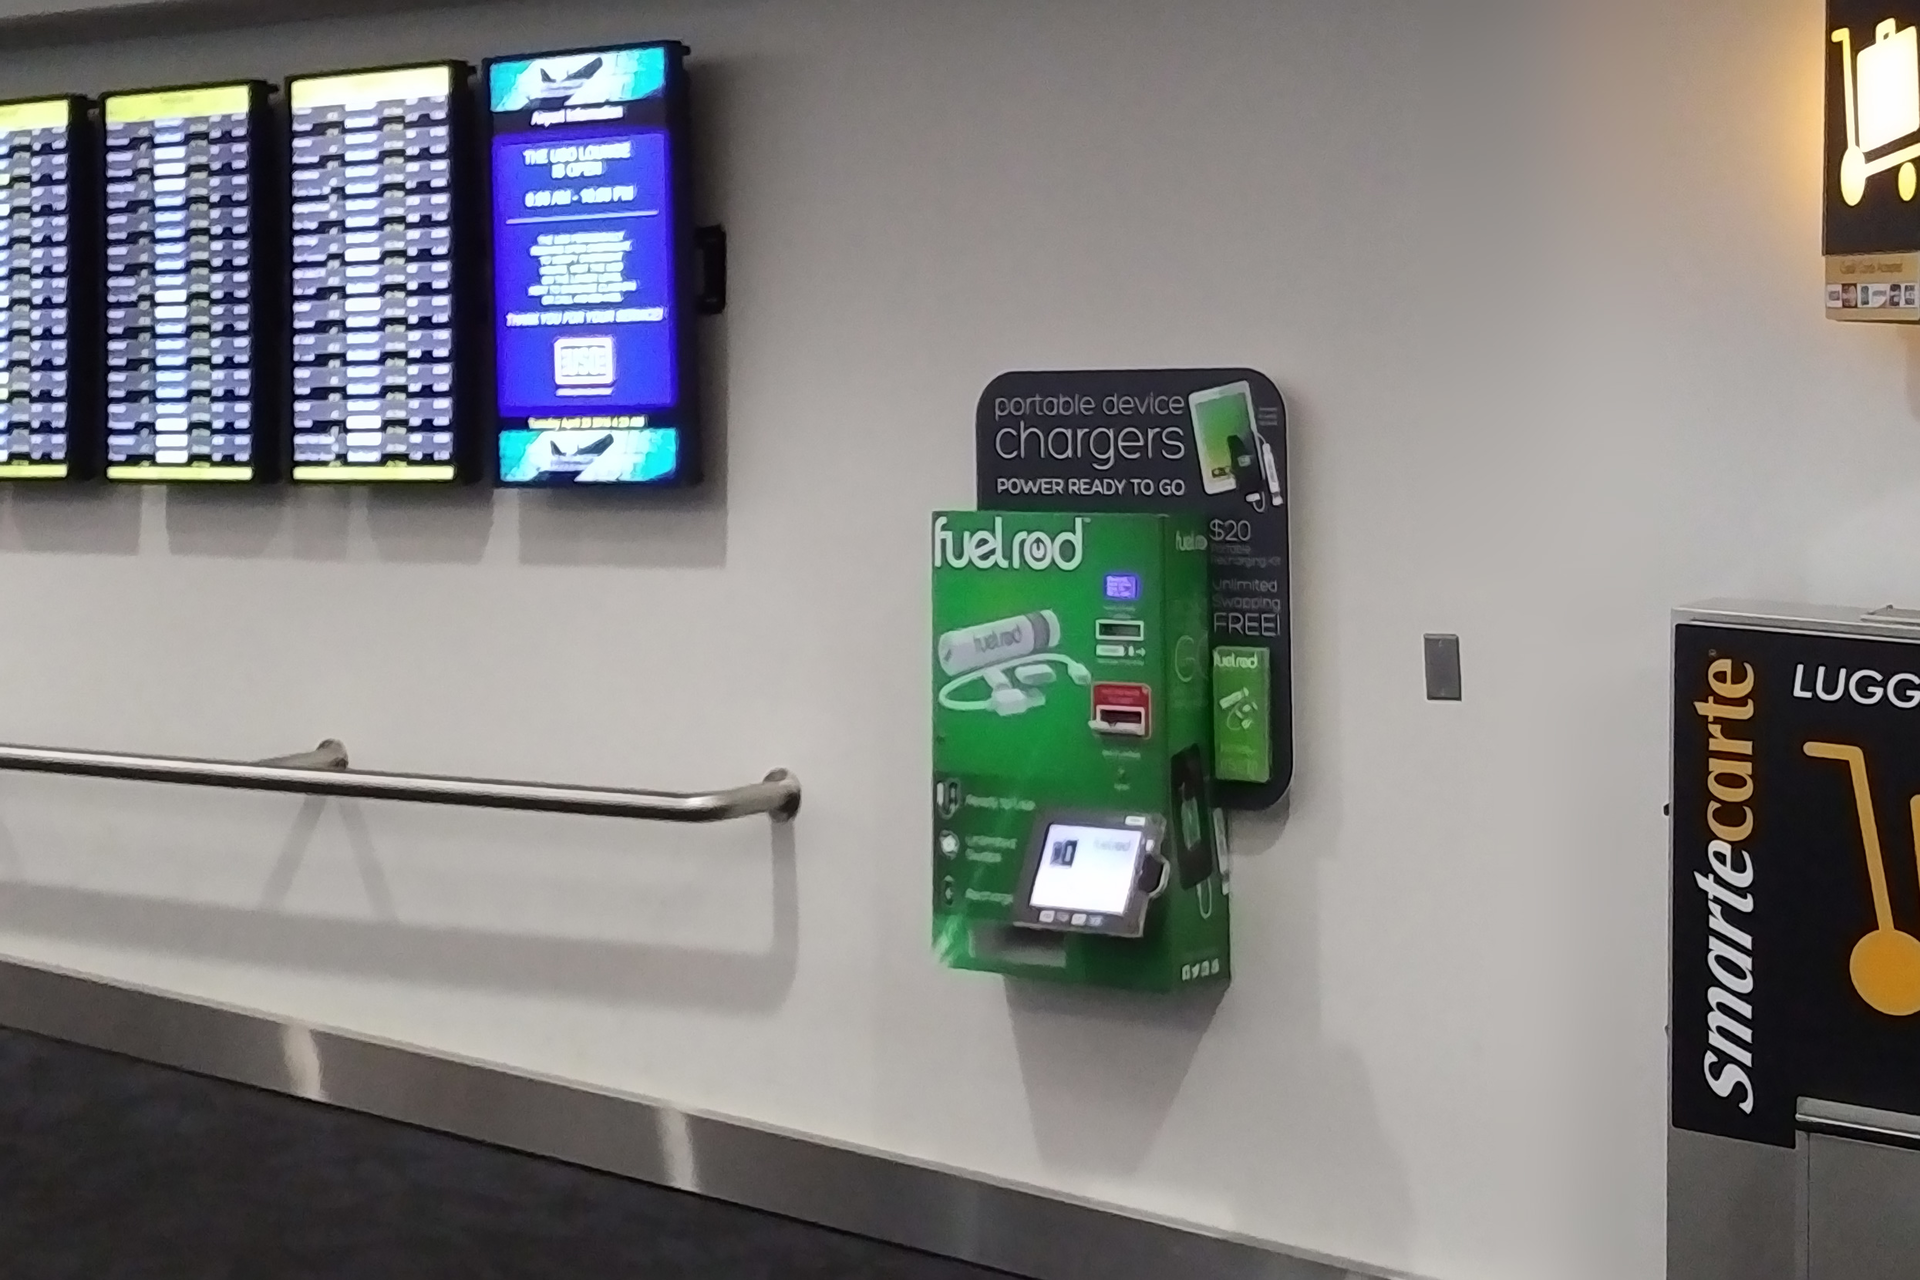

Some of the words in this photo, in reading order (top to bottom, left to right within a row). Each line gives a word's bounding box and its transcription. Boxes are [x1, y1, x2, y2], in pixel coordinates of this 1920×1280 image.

[994, 393, 1096, 421] portable
[1102, 392, 1185, 415] device
[995, 420, 1186, 470] chargers
[997, 478, 1064, 495] POWER
[1068, 478, 1127, 495] READY
[1130, 478, 1155, 495] TO
[1158, 478, 1186, 495] GO
[1209, 518, 1252, 541] $20
[934, 516, 1083, 571] fuelrod
[1212, 578, 1278, 592] Unlimited
[1212, 595, 1281, 612] Swapping
[1214, 612, 1281, 636] FREE!
[1793, 663, 1920, 708] LUGG
[1693, 657, 1755, 1115] smartecarte
